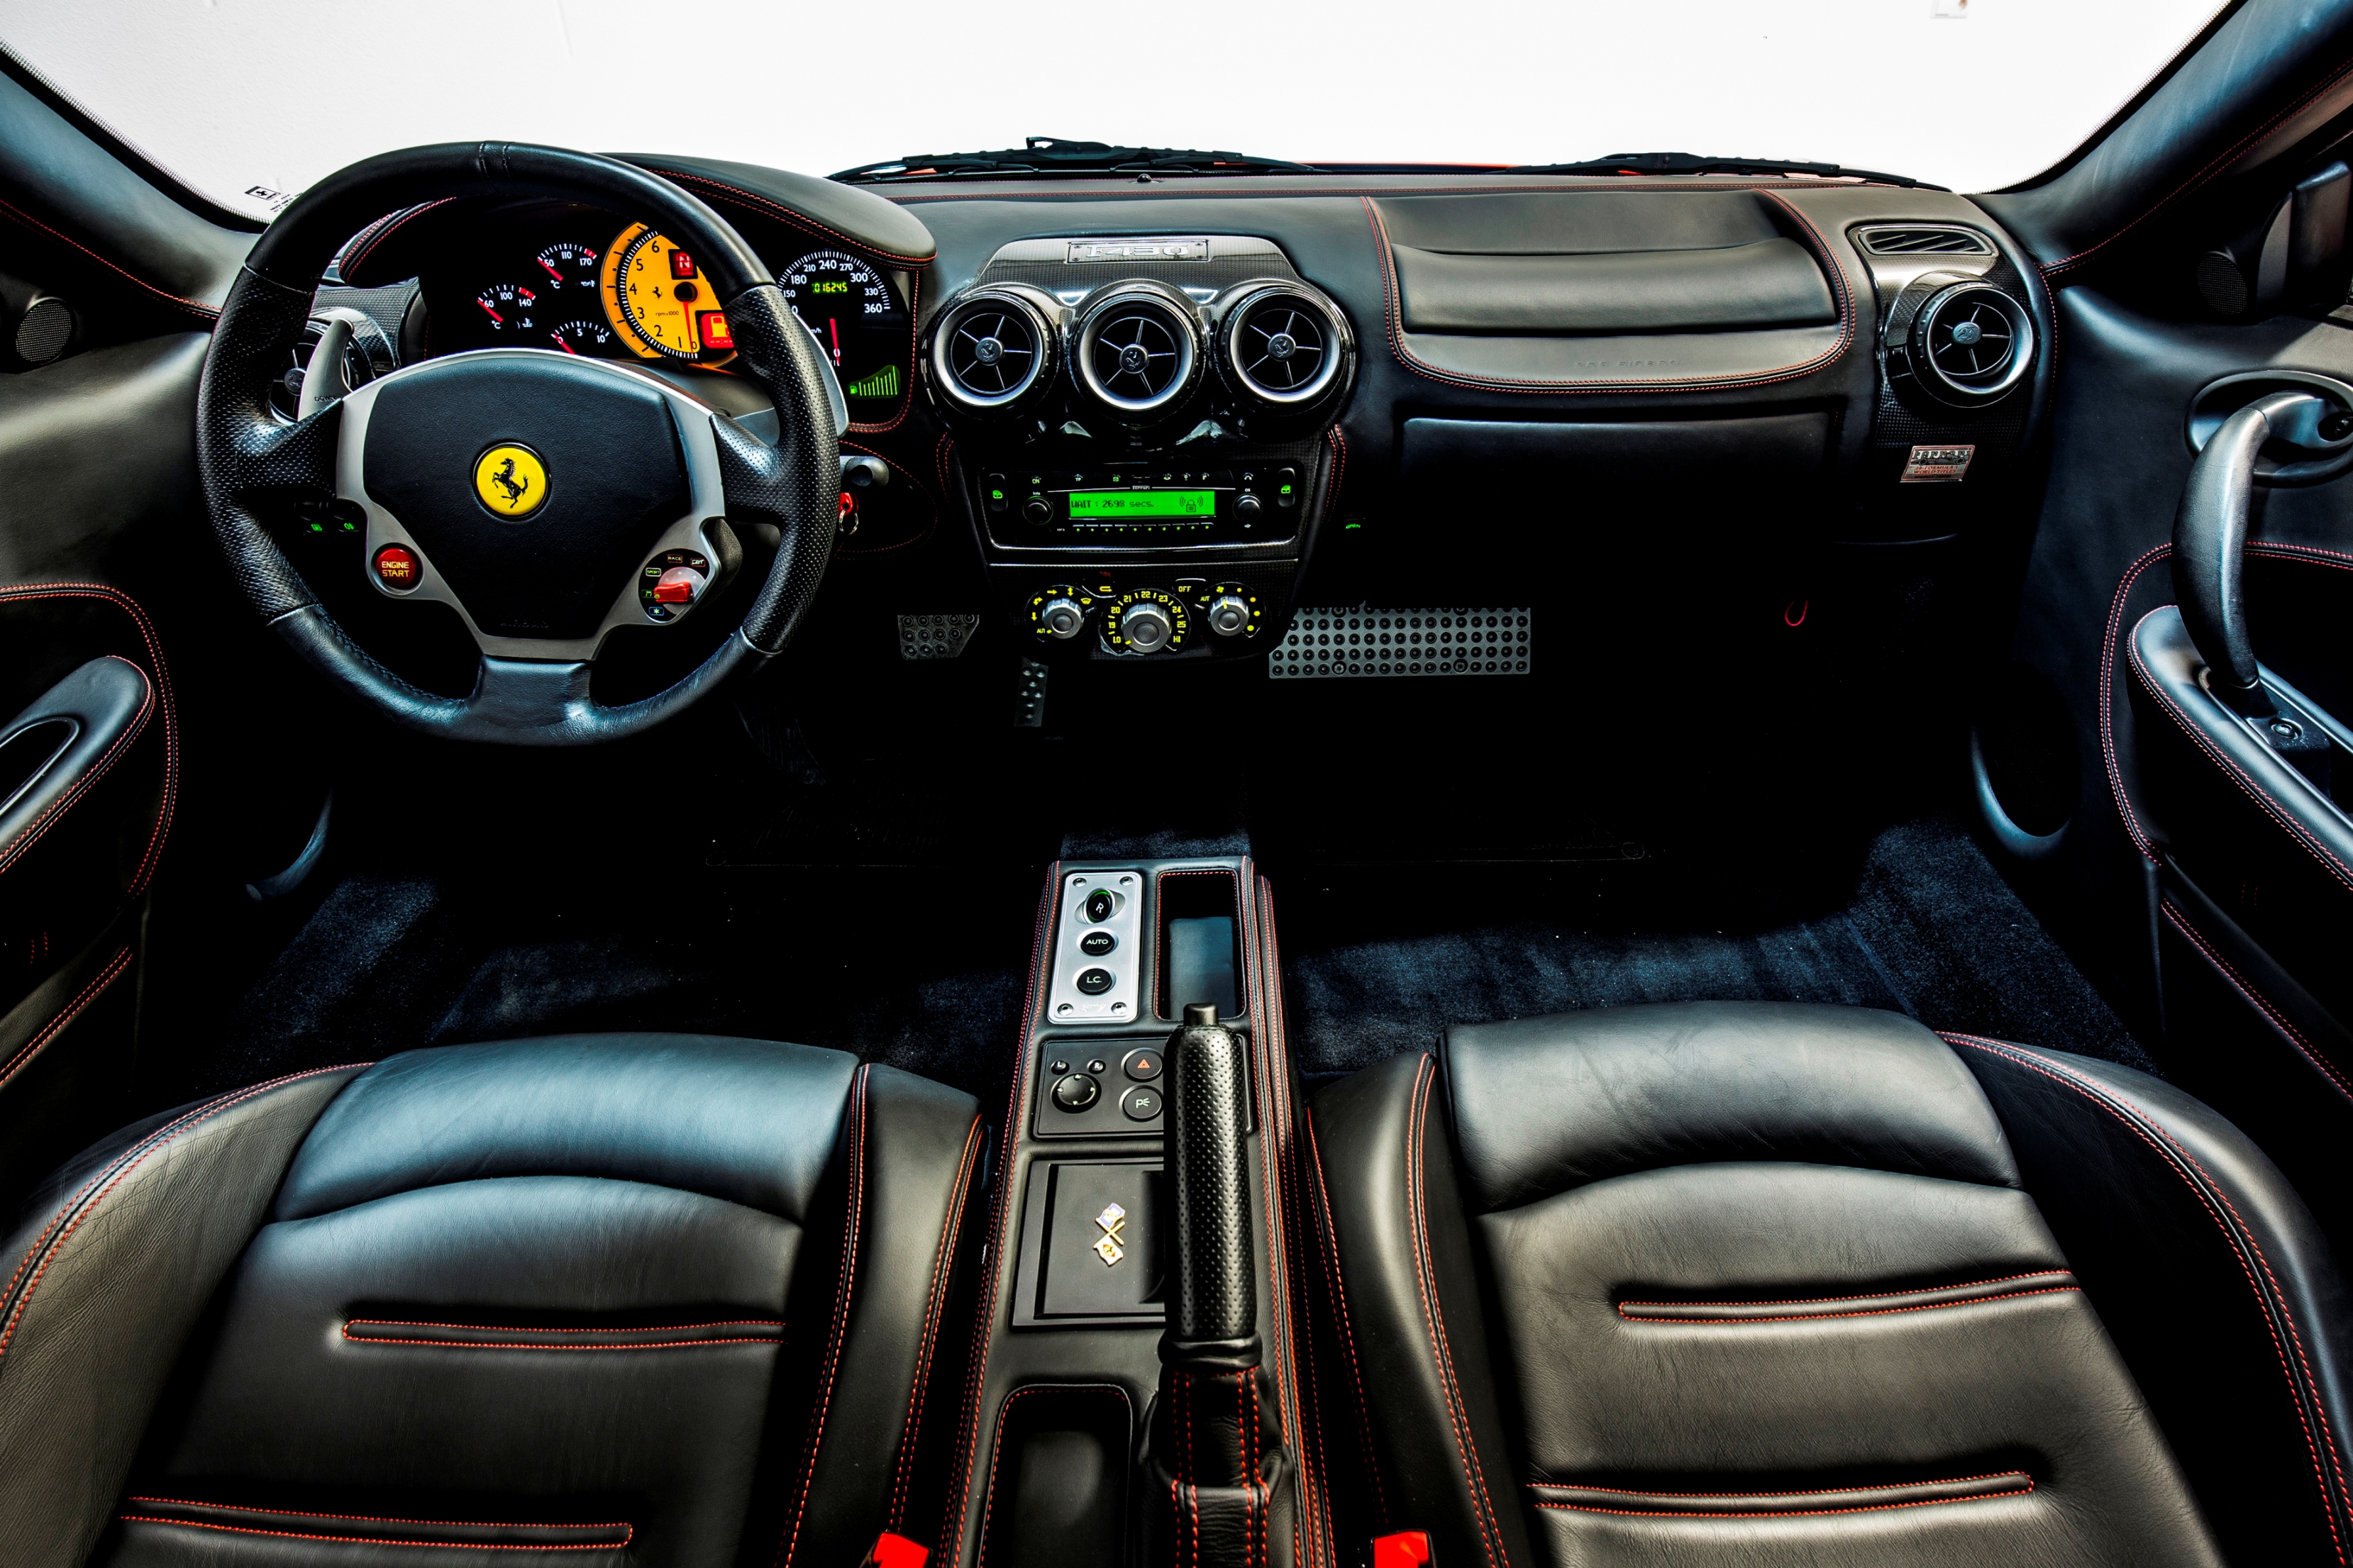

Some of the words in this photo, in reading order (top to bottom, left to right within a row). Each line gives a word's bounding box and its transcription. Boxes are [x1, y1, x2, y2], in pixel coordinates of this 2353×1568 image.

[651, 240, 660, 253] 6
[1086, 245, 1189, 257] F430
[543, 259, 555, 267] 50
[580, 257, 592, 266] 170
[636, 258, 643, 271] 5
[819, 260, 837, 269] 240
[804, 264, 816, 272] 210
[839, 263, 853, 272] 270
[791, 274, 807, 284] 180
[850, 273, 868, 282] 300
[629, 283, 637, 295] 4
[814, 282, 848, 293] 016245
[519, 299, 532, 307] 140
[637, 307, 645, 319] 3
[864, 304, 882, 313] 360
[577, 328, 583, 337] 5
[654, 325, 663, 337] 2
[1095, 903, 1104, 914] R
